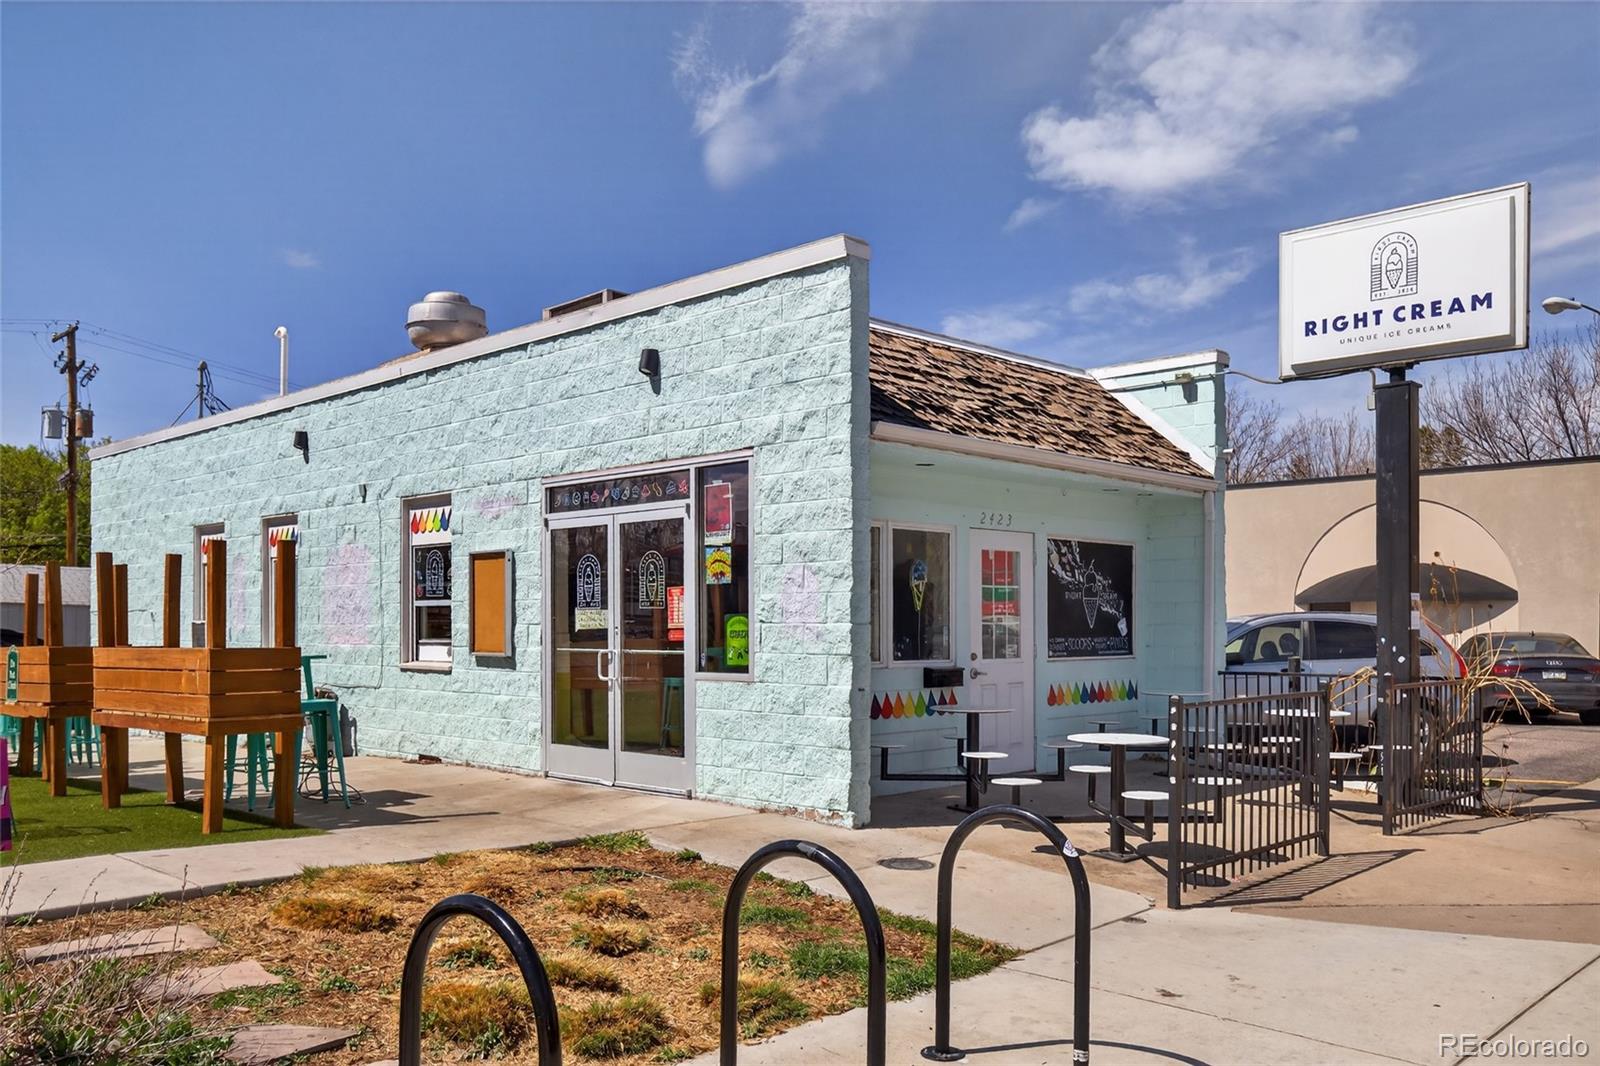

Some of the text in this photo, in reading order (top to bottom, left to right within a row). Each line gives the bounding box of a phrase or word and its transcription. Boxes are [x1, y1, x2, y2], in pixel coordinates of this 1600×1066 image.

[1304, 292, 1493, 337] RIGHT CREAM
[1339, 322, 1452, 345] UNIQUE ICE CREAMS
[980, 511, 1013, 527] 2423
